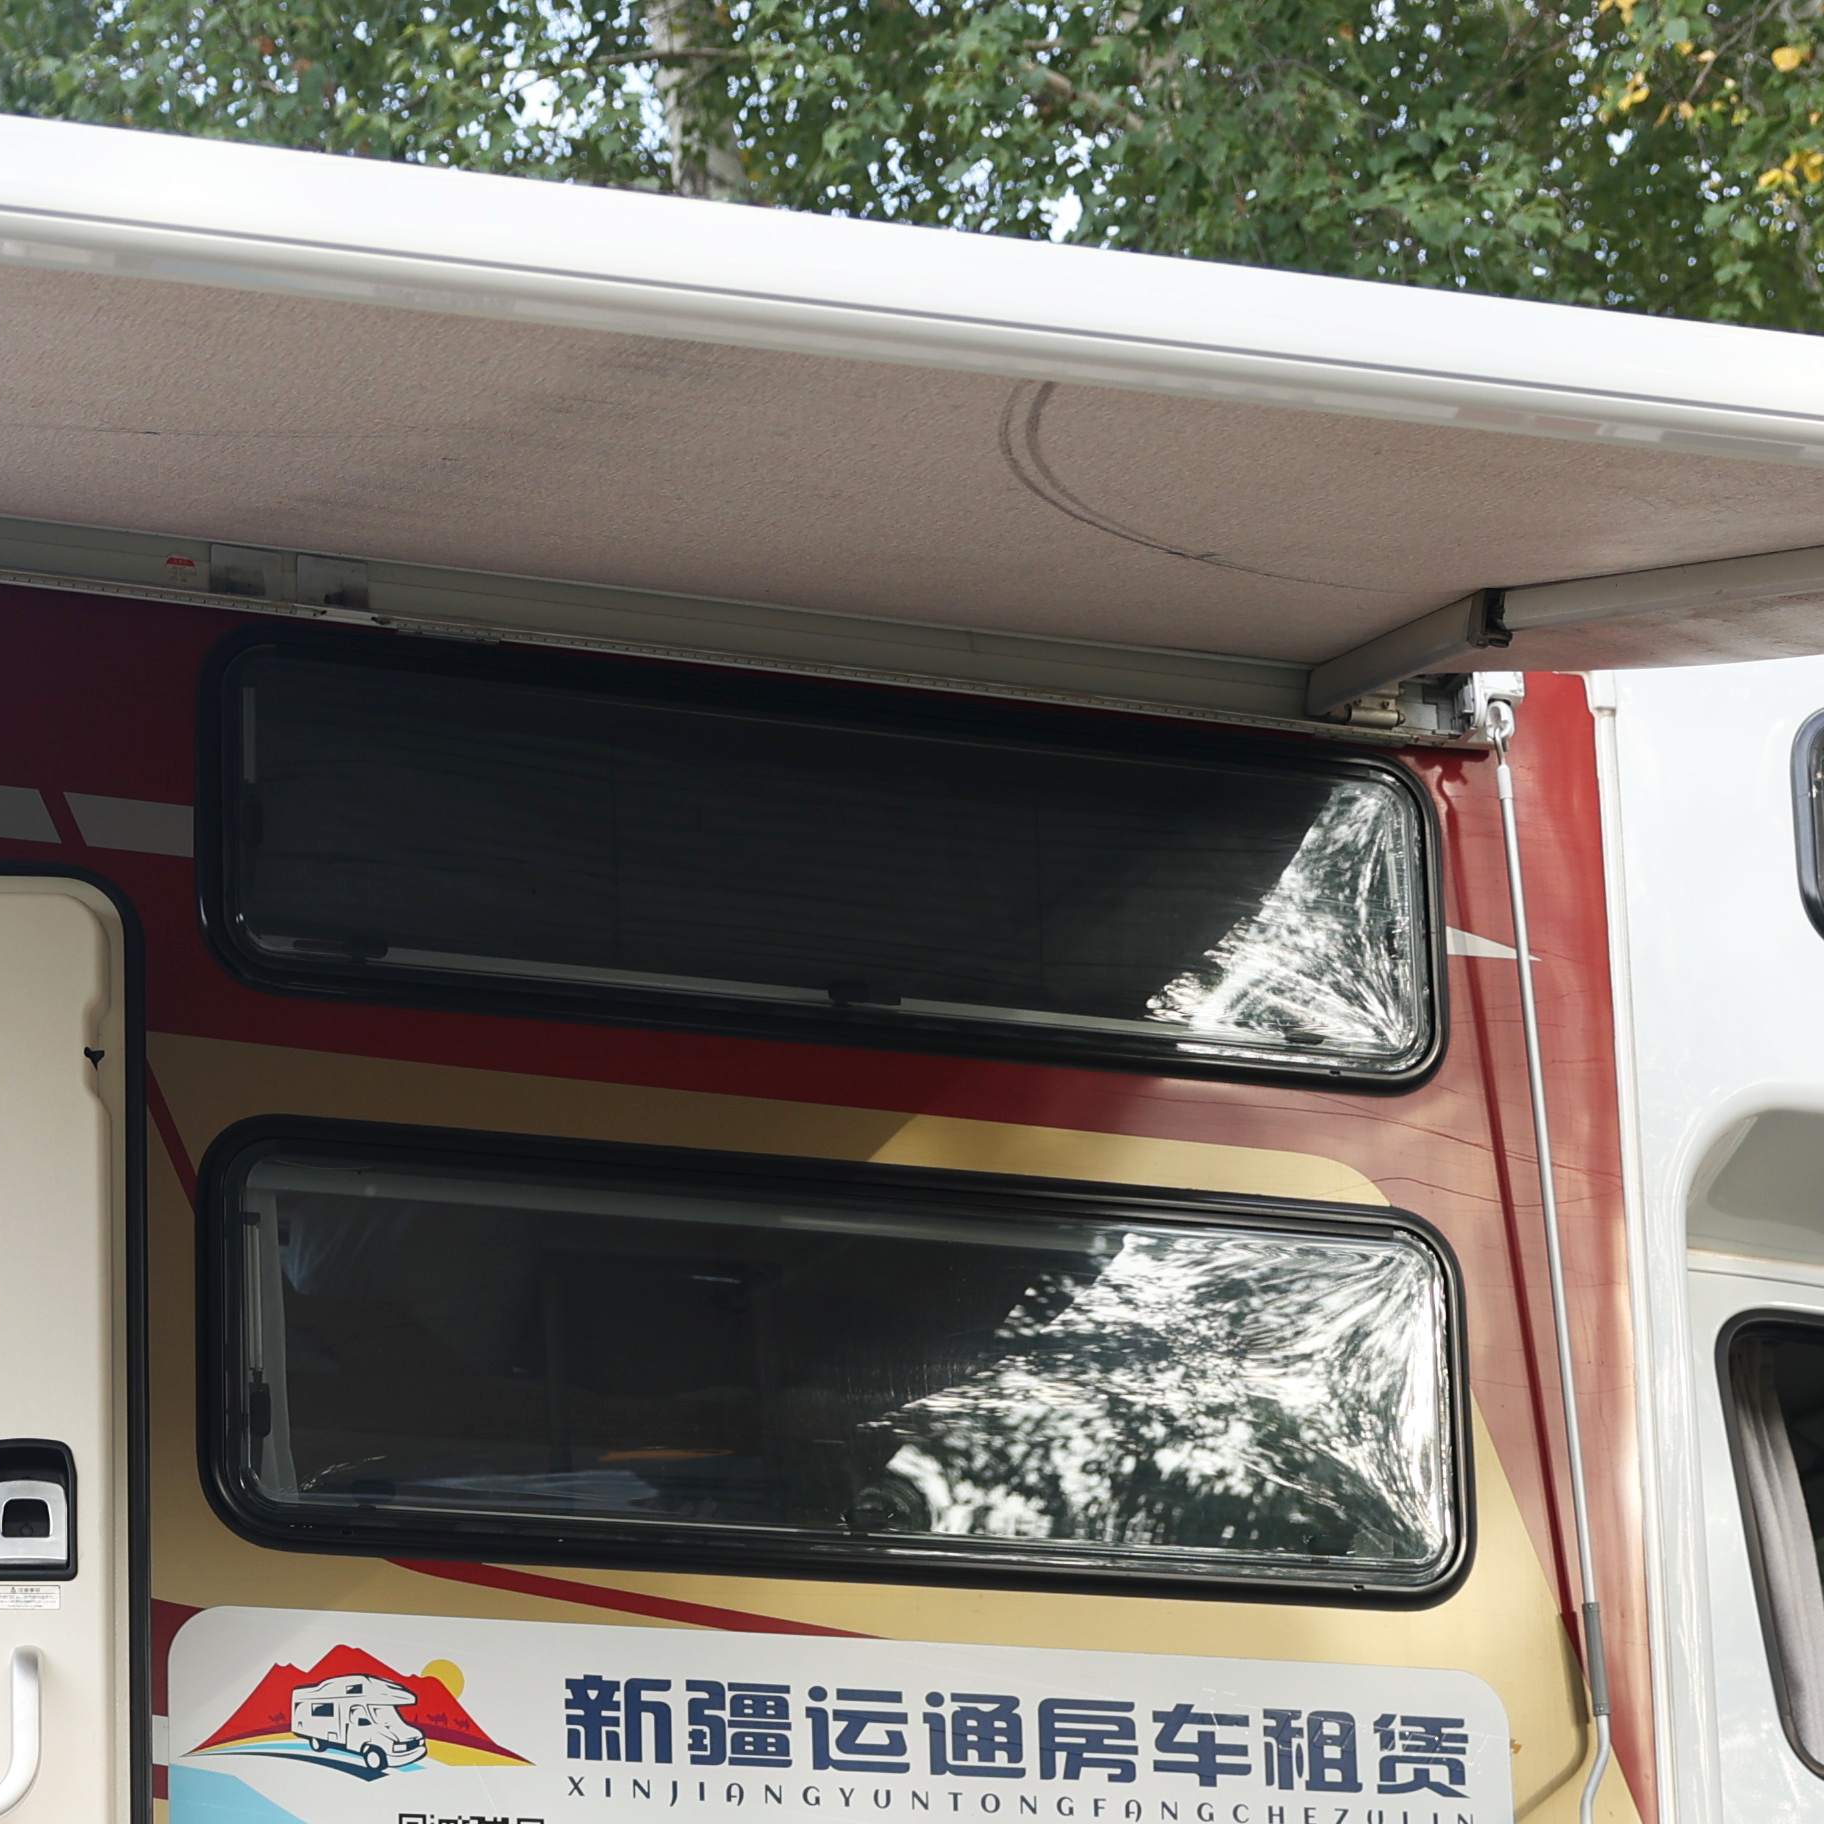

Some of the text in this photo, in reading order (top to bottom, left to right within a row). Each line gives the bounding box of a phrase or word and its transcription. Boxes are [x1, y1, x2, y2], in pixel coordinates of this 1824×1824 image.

[565, 1674, 1471, 1799] 新疆运通房车租赁
